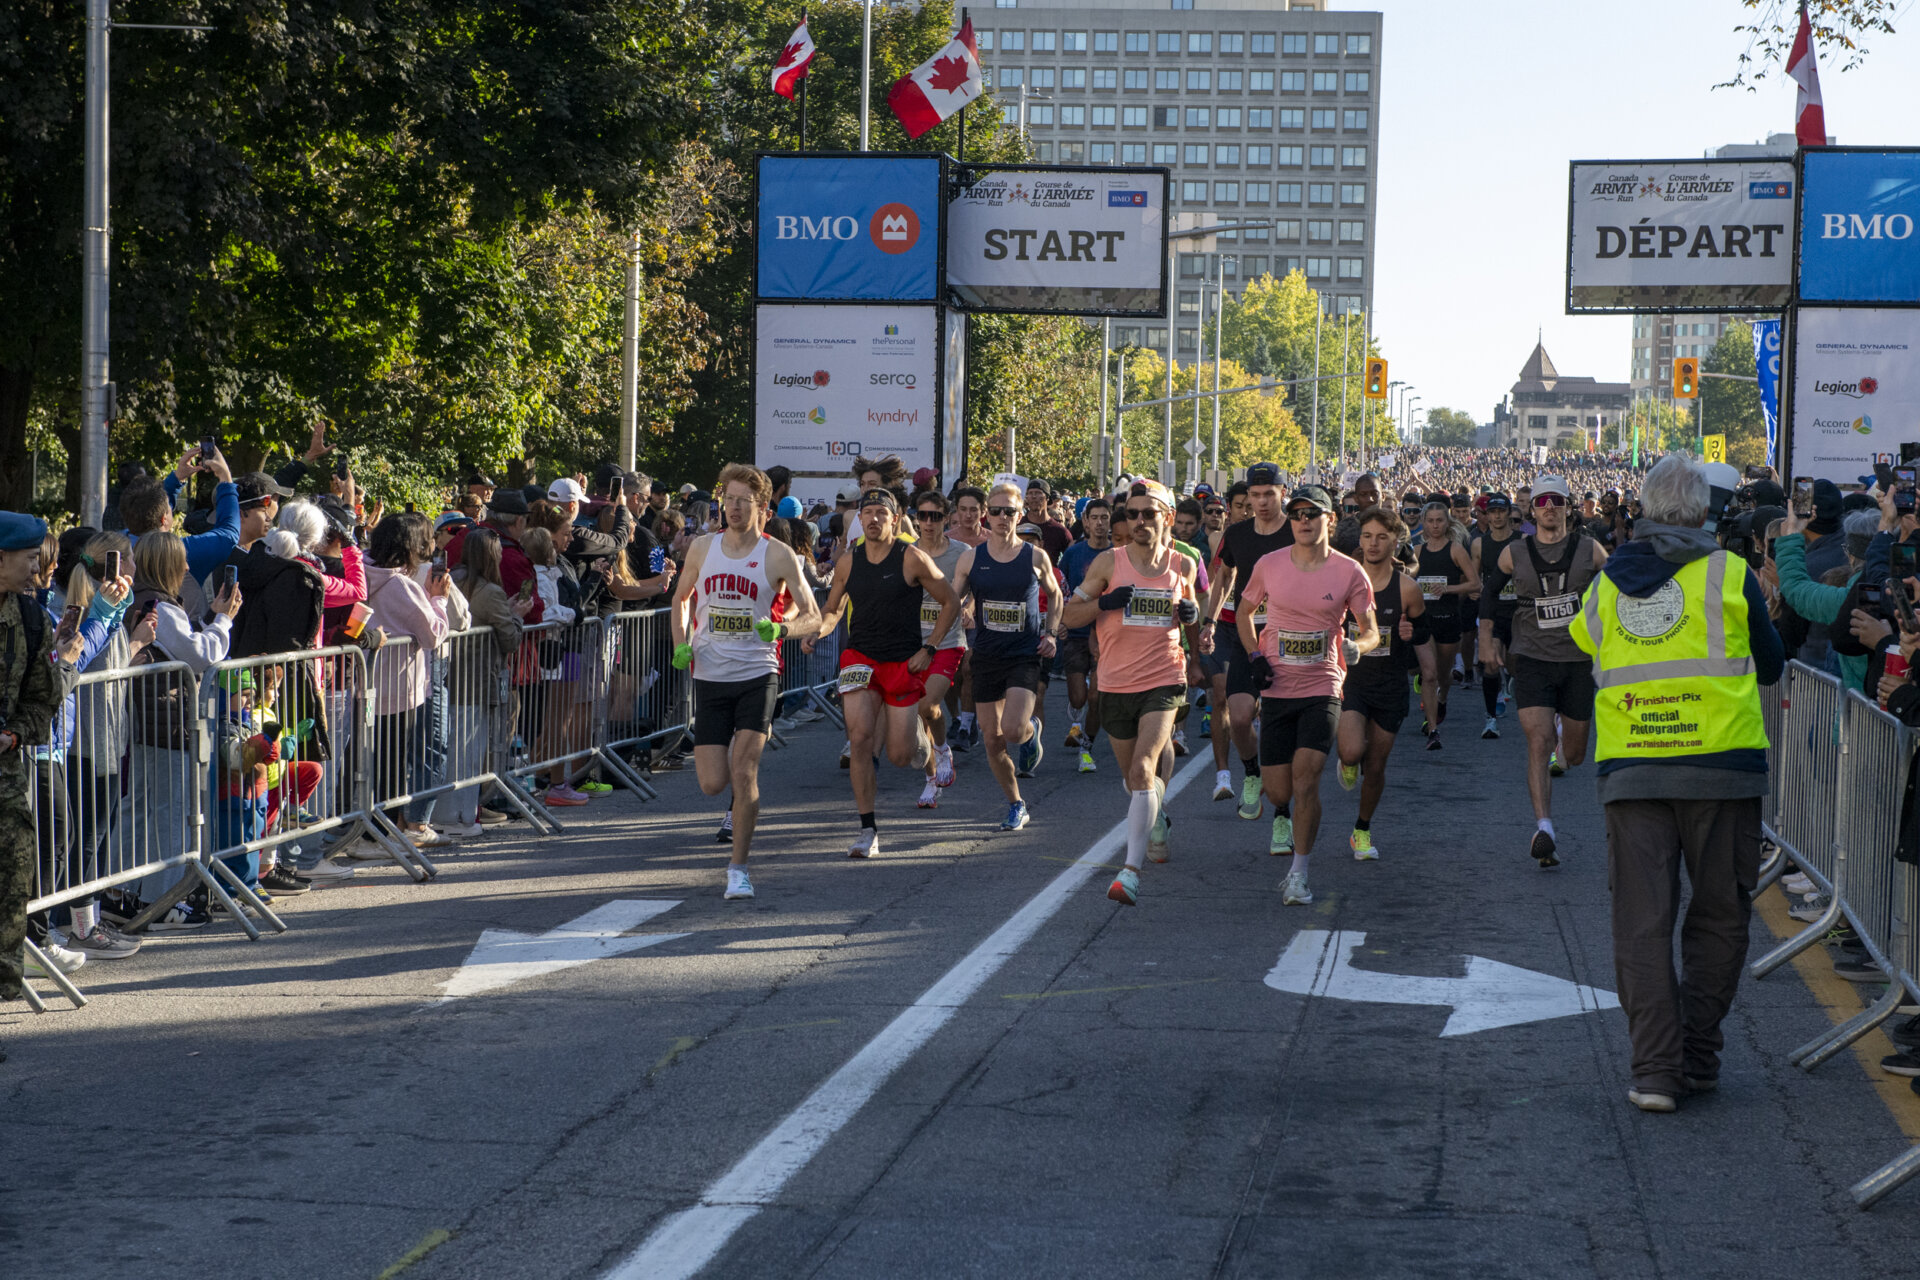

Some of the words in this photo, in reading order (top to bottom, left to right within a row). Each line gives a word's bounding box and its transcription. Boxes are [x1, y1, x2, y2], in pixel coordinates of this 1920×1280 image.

[979, 180, 1008, 188] Canada
[1608, 174, 1639, 182] Canada
[1668, 174, 1698, 182] Course
[1591, 183, 1638, 194] ARMY
[1665, 178, 1734, 194] L'ARMÉE
[964, 188, 1007, 199] ARMY
[1032, 186, 1095, 200] L'ARMÉE
[1663, 194, 1675, 202] du
[1676, 194, 1708, 202] Canada
[987, 199, 1003, 207] Run
[1042, 200, 1071, 208] Canada
[775, 215, 859, 240] BMO
[1820, 213, 1914, 240] BMO
[1595, 217, 1784, 259] DÉPART
[983, 228, 1125, 262] START
[773, 373, 812, 388] Legion
[870, 373, 917, 386] serco
[1814, 380, 1857, 395] Legion
[772, 409, 806, 419] Accora
[867, 408, 918, 426] kyndryl
[1812, 418, 1850, 428] Accora
[825, 441, 862, 455] 100
[704, 573, 758, 602] OTTAWA
[1133, 598, 1171, 614] 16902
[1542, 603, 1574, 619] 11750
[923, 609, 941, 620] 179
[988, 609, 1019, 622] 20696
[715, 615, 751, 630] 27634
[1615, 625, 1625, 636] TO
[1624, 634, 1639, 645] SEE
[1640, 637, 1664, 646] YOUR
[1664, 614, 1690, 641] PHOTOS
[1285, 639, 1321, 654] 22834
[842, 671, 869, 683] 14936
[1640, 710, 1680, 722] Official
[1630, 722, 1699, 735] Photographer
[1626, 739, 1703, 748] www.FinisherPix.com
